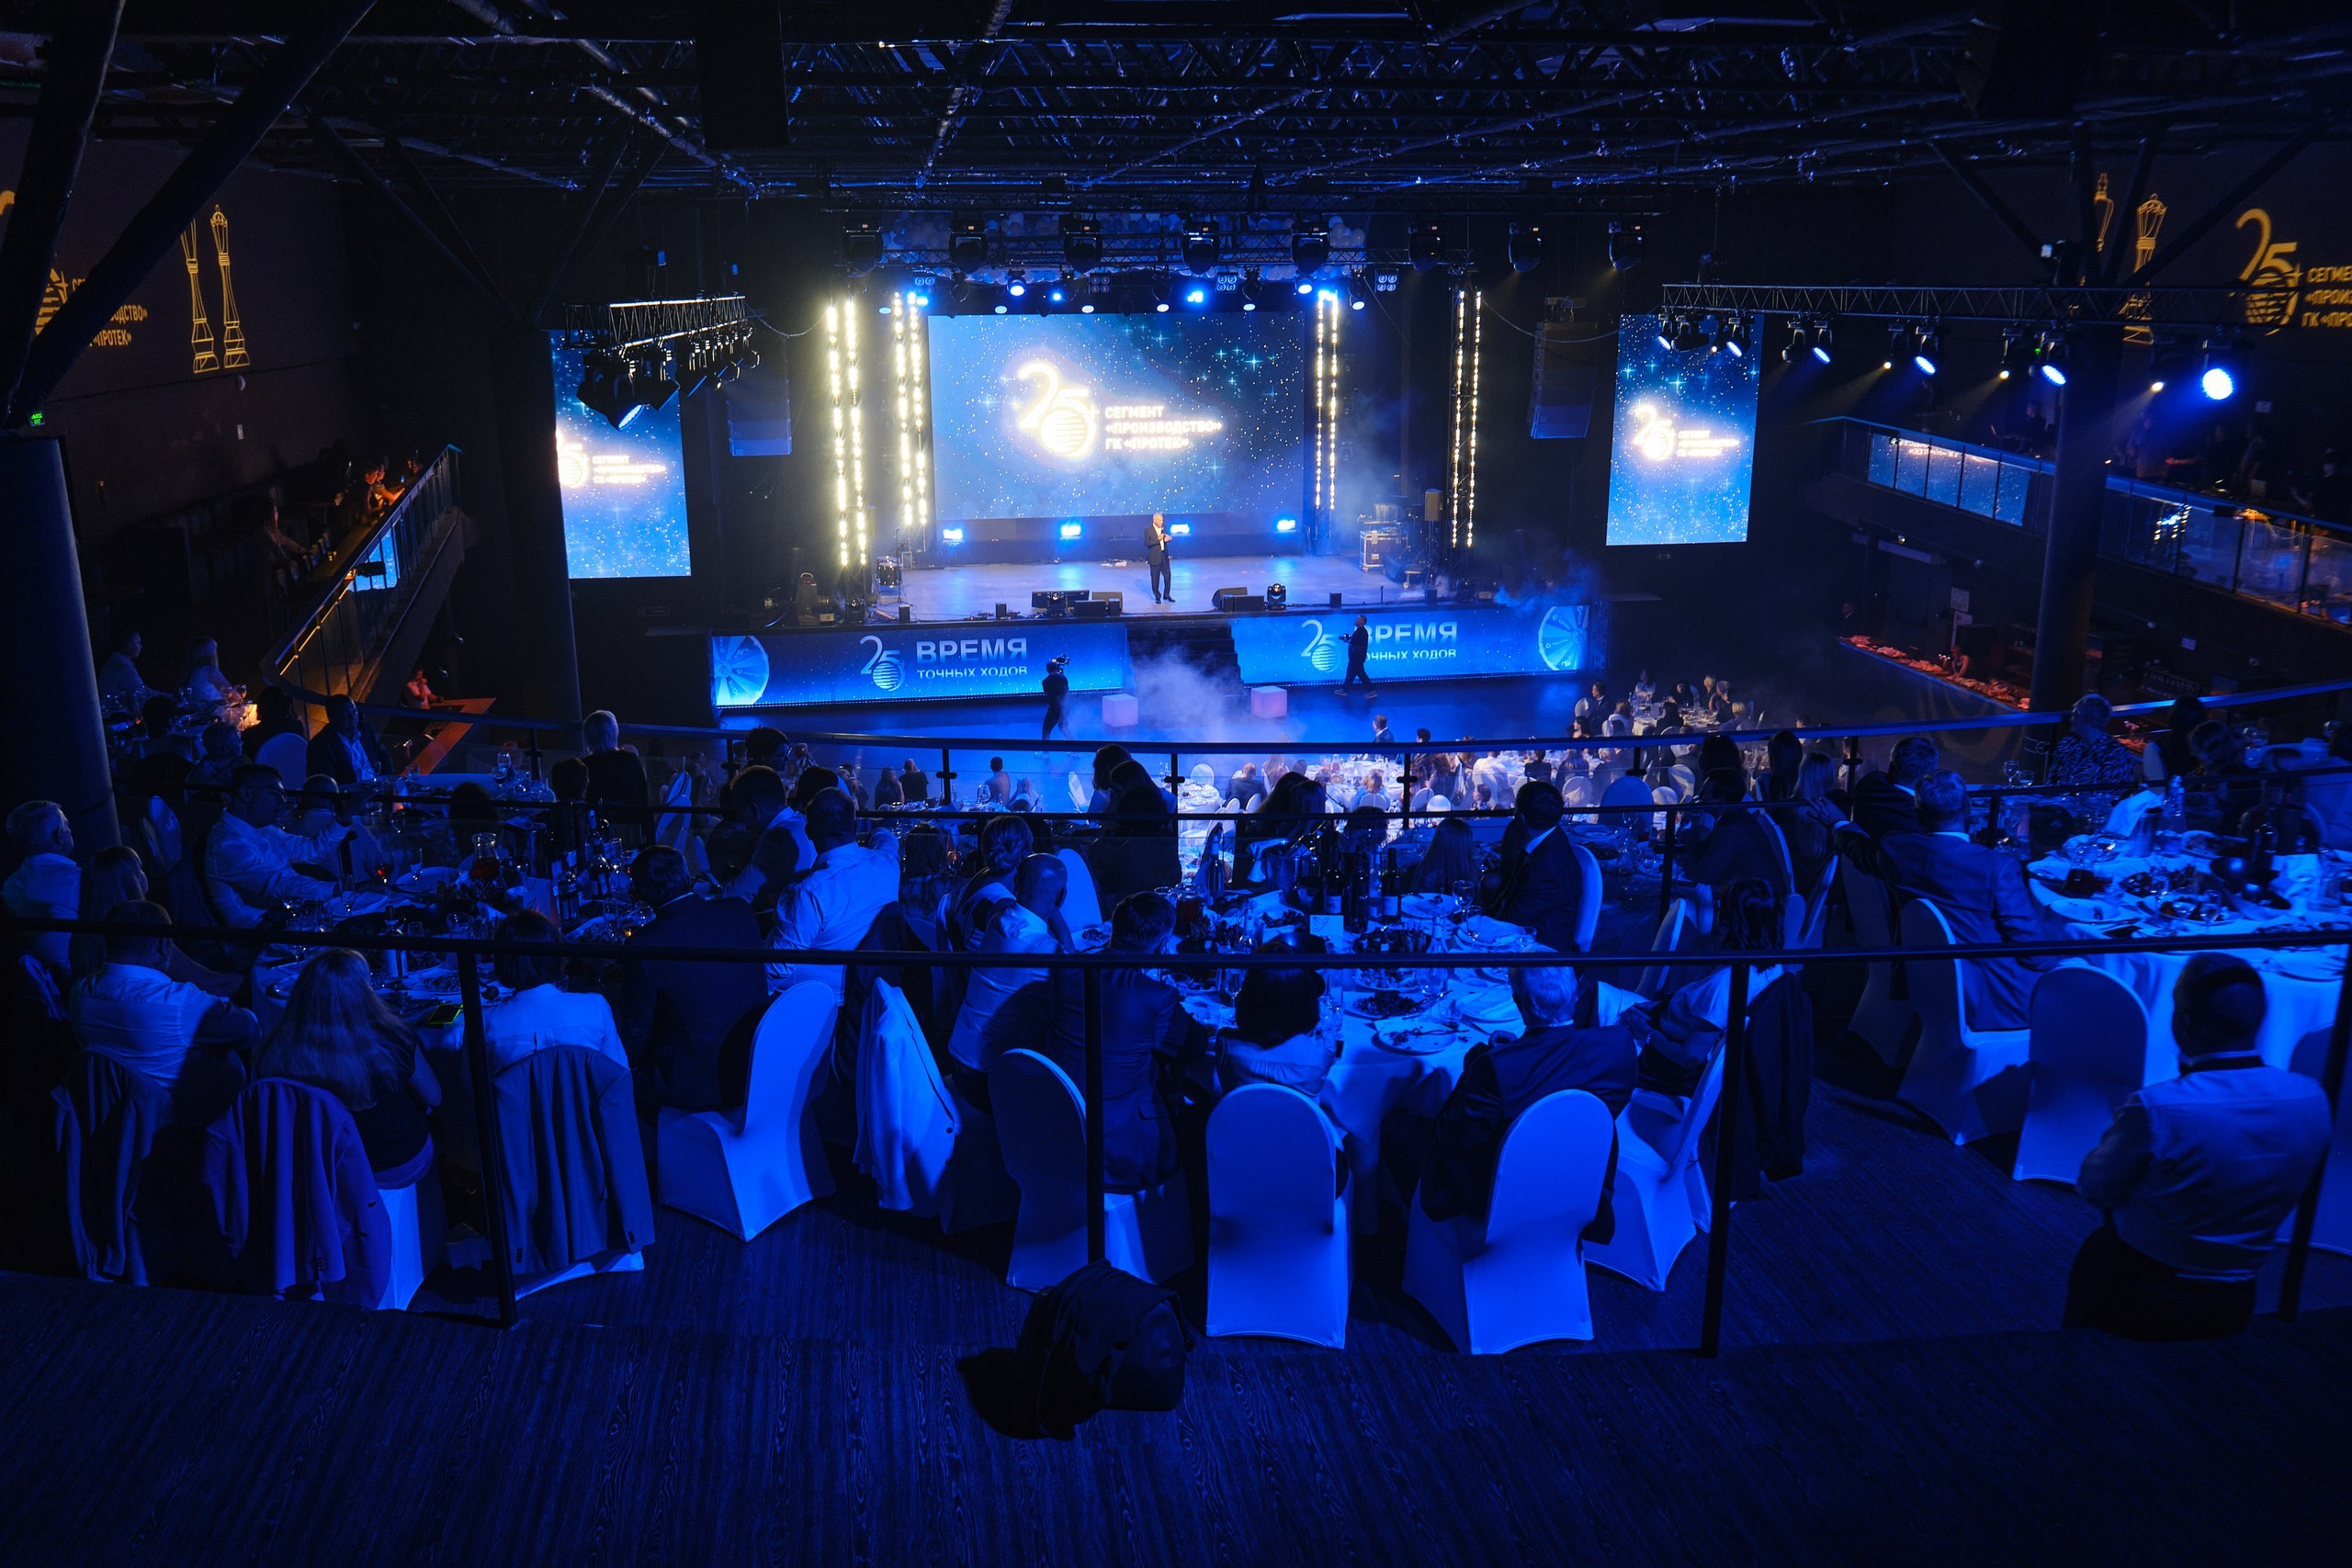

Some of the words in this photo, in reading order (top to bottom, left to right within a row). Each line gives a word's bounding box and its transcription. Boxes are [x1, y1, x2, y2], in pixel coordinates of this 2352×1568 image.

[2301, 311, 2321, 328] ГК
[1017, 362, 1097, 457] 25
[1104, 405, 1165, 419] СЕГМЕНТ
[1105, 421, 1223, 434] «ПРОИЗВОДСТВО»
[1105, 437, 1123, 450] ГК
[1124, 437, 1190, 450] «ПРОТЕК»
[916, 637, 1028, 664] ВРЕМЯ
[1300, 619, 1340, 672] 25
[1412, 649, 1457, 660] ХОДОВ
[859, 635, 906, 692] 25
[917, 667, 976, 680] ТОЧНЫХ
[978, 665, 1028, 678] ХОДОВ
